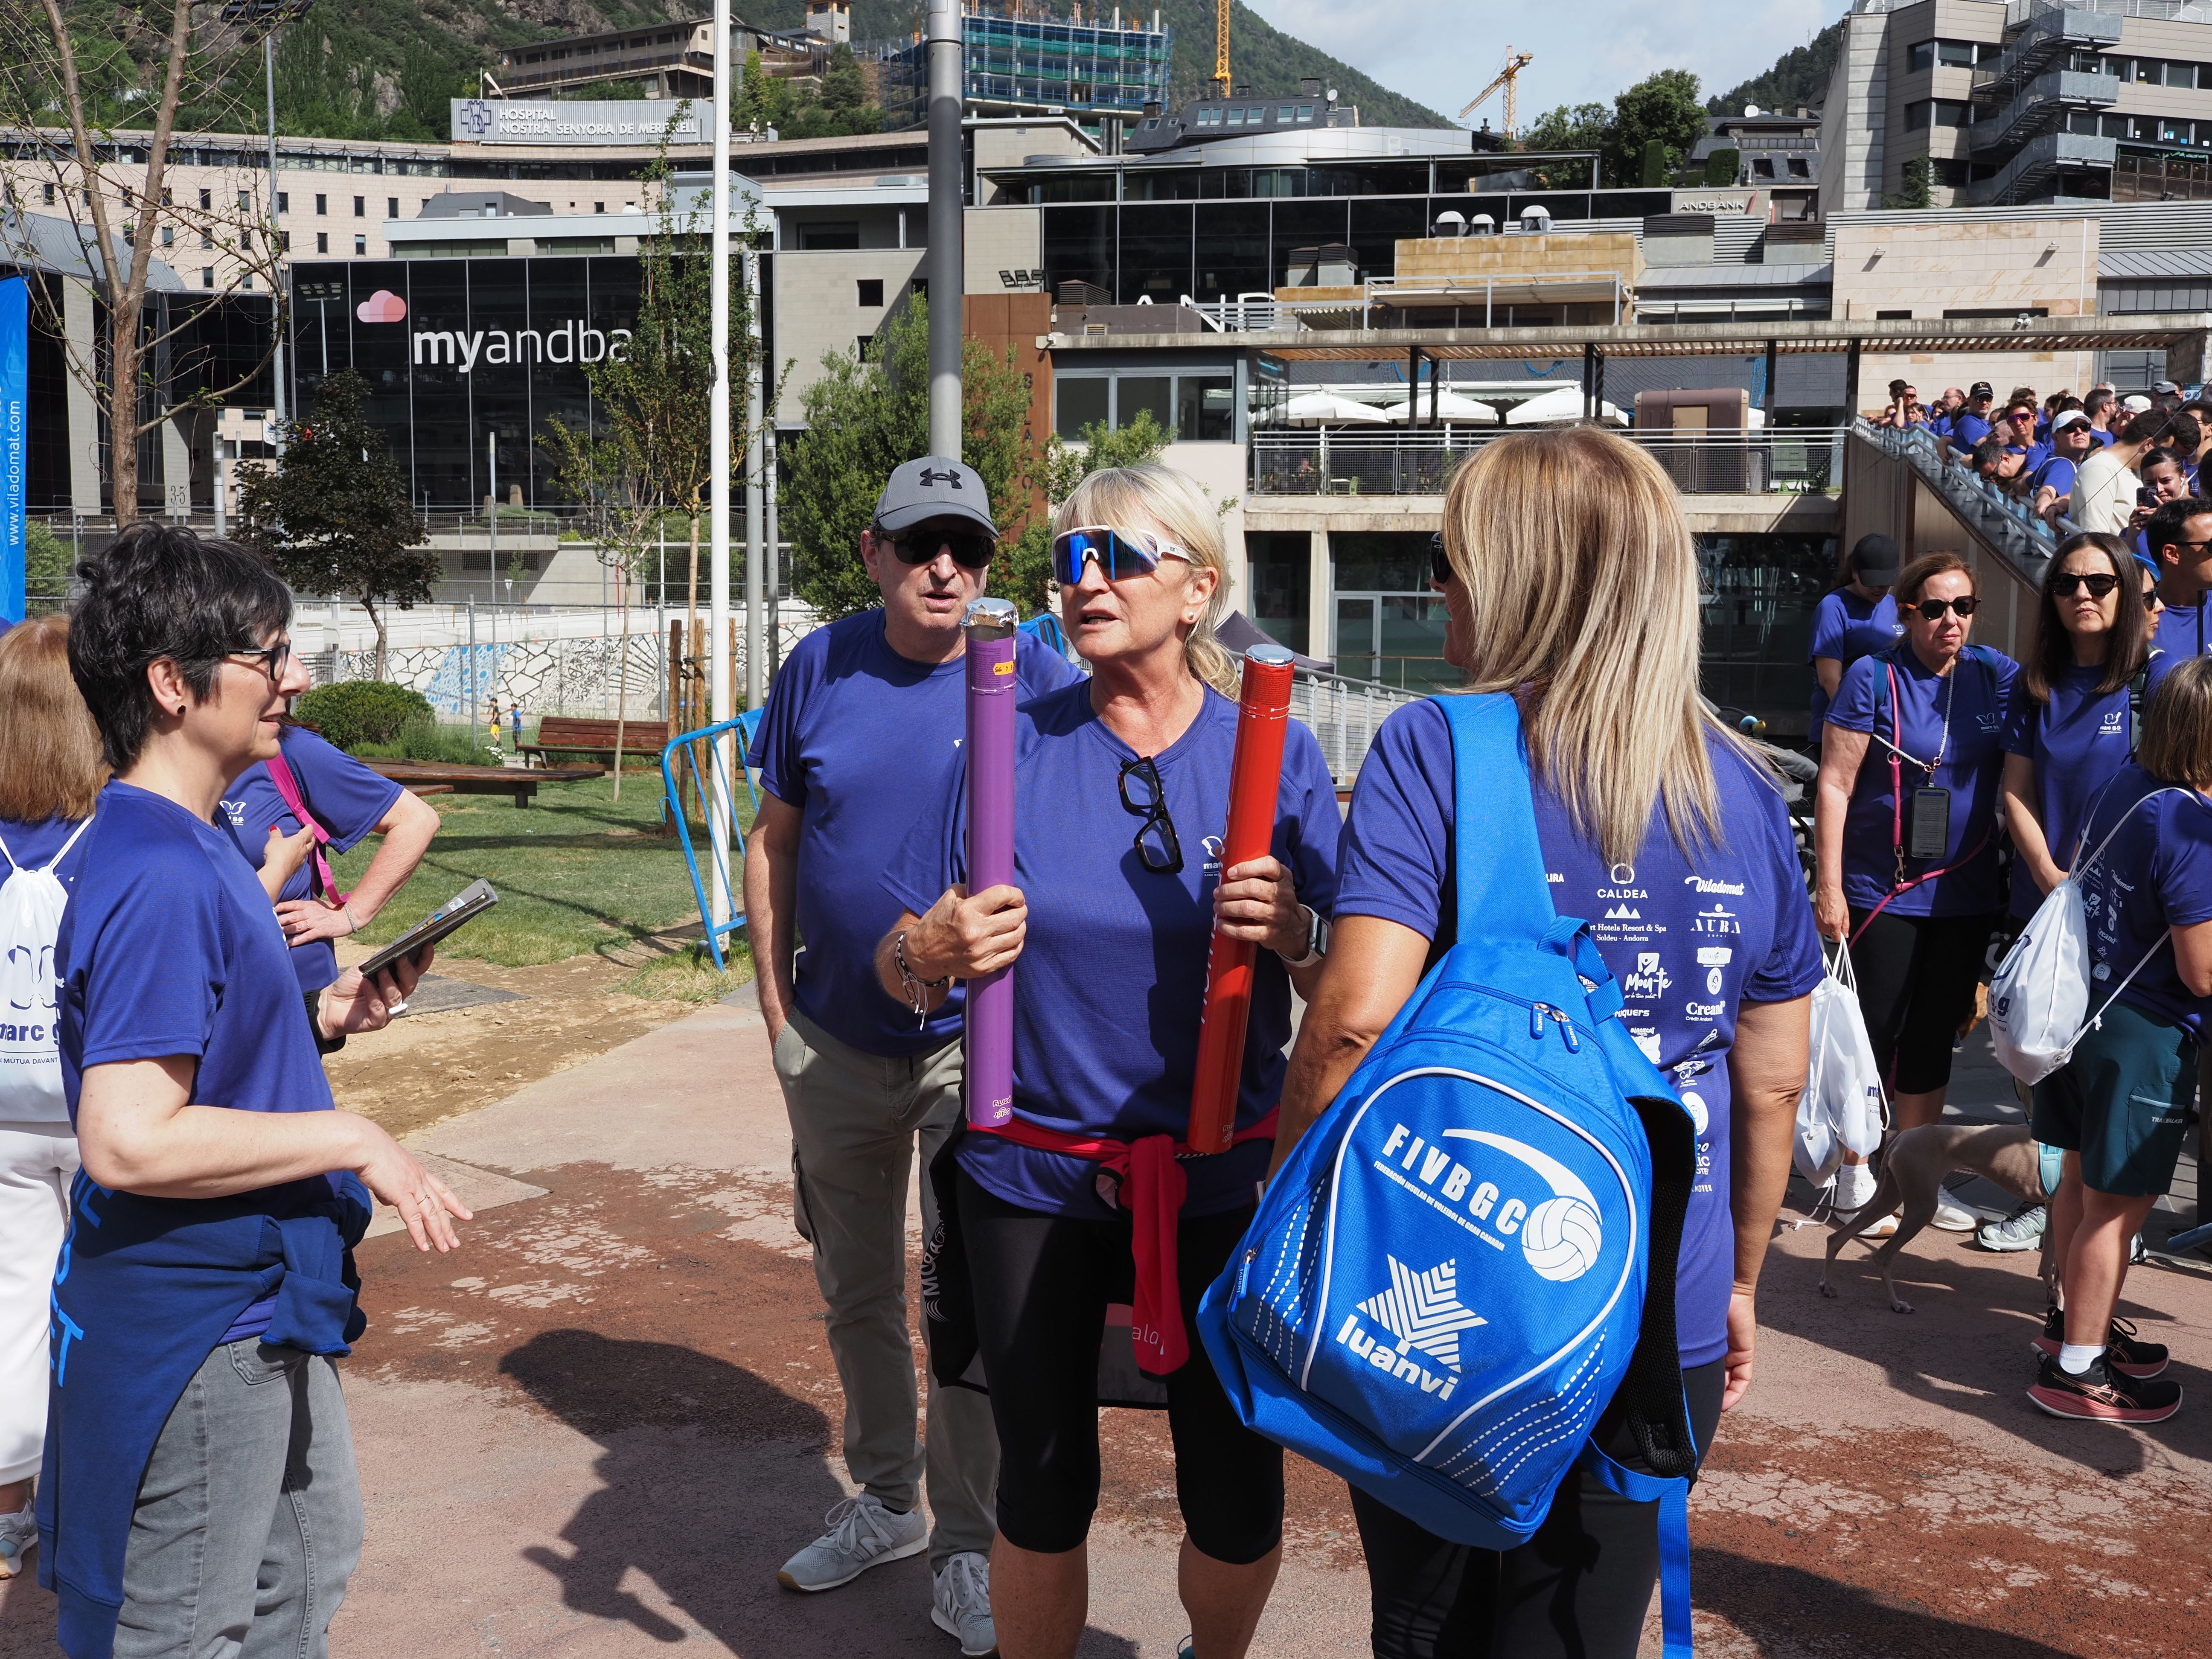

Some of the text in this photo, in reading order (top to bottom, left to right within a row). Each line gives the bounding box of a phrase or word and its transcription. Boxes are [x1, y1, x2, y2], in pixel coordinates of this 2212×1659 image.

[499, 109, 556, 120] HOSPITAL
[500, 123, 552, 134] NOSTRA
[556, 123, 614, 135] SENYORA
[619, 123, 634, 134] DE
[1679, 201, 1744, 210] ANDBANK
[414, 319, 633, 373] myandba
[7, 400, 20, 546] www.viladomat.com
[170, 485, 186, 505] 3-5
[1597, 888, 1648, 899] CALDEA
[1684, 876, 1745, 896] Viladomat
[1597, 923, 1621, 931] Hotels
[1622, 924, 1644, 932] Resort
[1655, 925, 1667, 934] Spa
[1686, 1001, 1723, 1015] Creand
[1566, 1025, 1578, 1046] luanvi
[3, 1057, 58, 1065] MÚTUA DAVANT
[992, 1095, 1011, 1107] party
[1382, 1123, 1527, 1235] FIVBGC
[1374, 1160, 1505, 1252] FEDERACIÓN INSULAR DE VOLEIBOL DE GRAN CANARIA
[1336, 1313, 1459, 1401] luanvi
